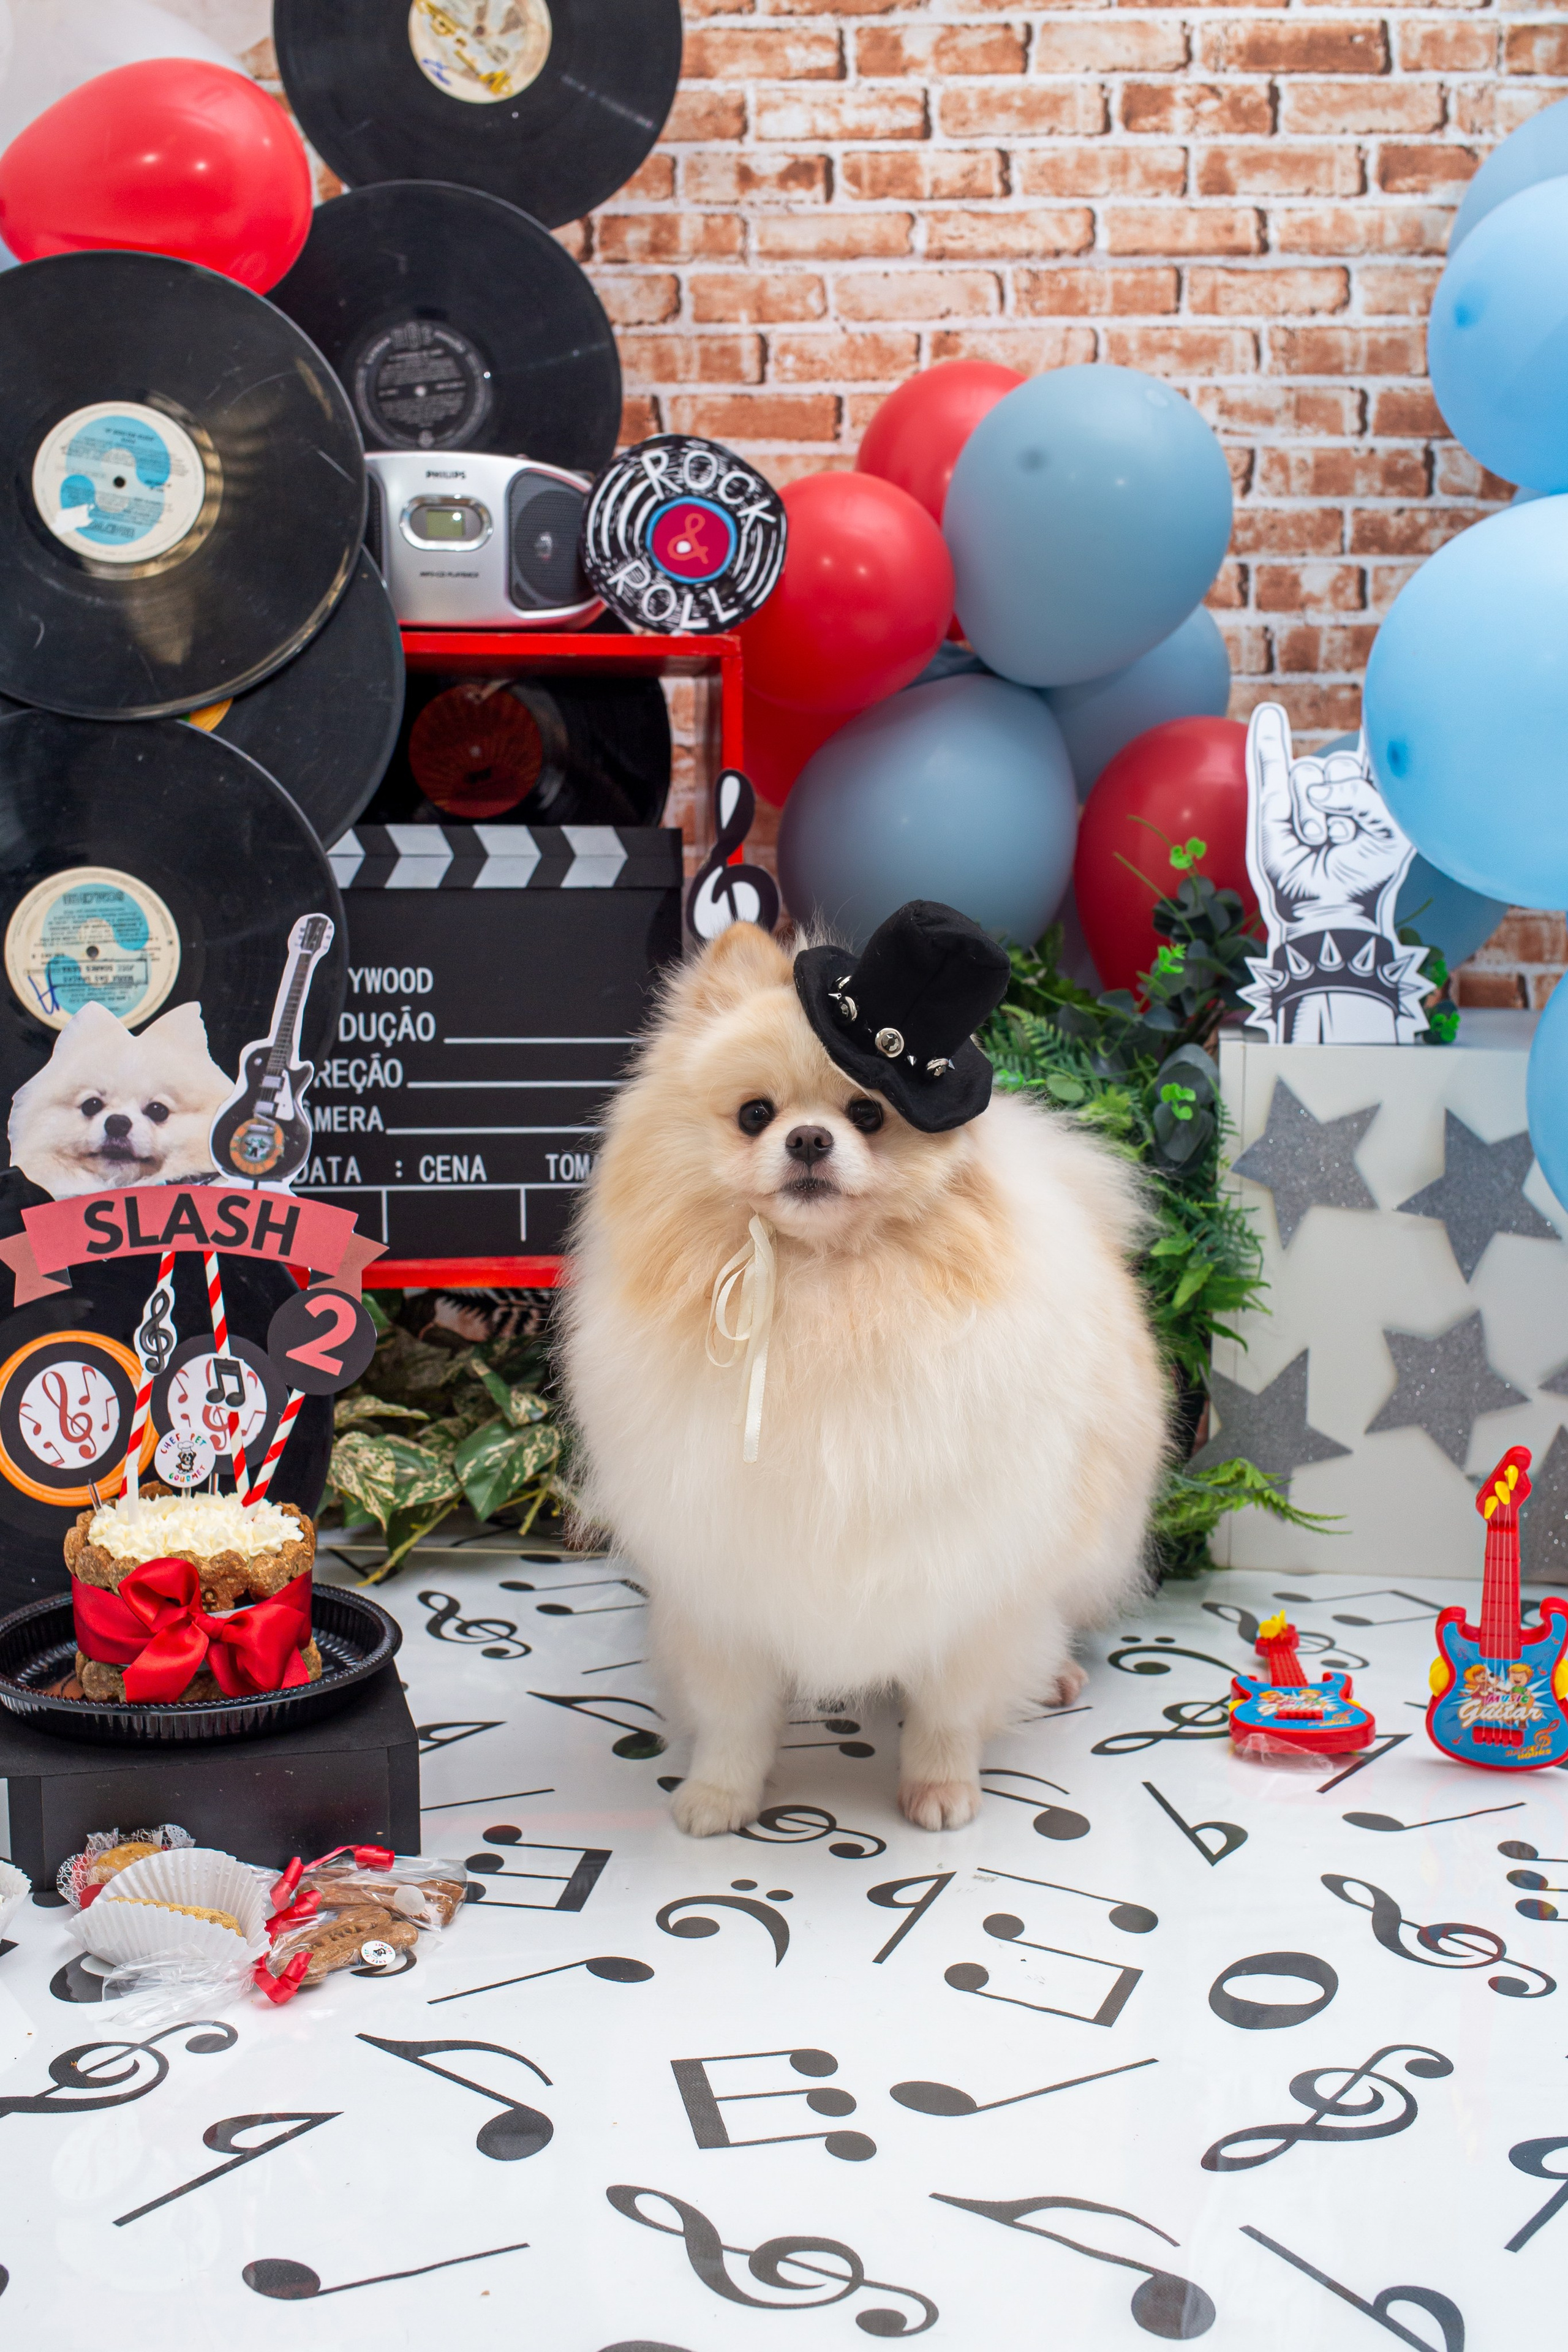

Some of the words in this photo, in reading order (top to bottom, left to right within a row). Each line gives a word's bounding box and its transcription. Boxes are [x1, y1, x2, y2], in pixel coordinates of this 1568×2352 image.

[642, 450, 776, 535] ROCK
[667, 513, 709, 564] &
[607, 560, 739, 629] ROLL
[347, 967, 434, 993] YWOOD
[338, 1005, 436, 1047] DUÇÃO
[313, 1052, 403, 1095] REÇÃO
[303, 1099, 384, 1133] MERA
[419, 1154, 487, 1183] CENA
[545, 1153, 592, 1181] TOM
[84, 1193, 300, 1257] SLASH
[285, 1294, 357, 1376] 2
[160, 1433, 180, 1454] CHEF
[190, 1433, 206, 1446] PET
[168, 1464, 205, 1482] GOURMET
[1458, 1698, 1544, 1728] Guitar
[1487, 1694, 1530, 1703] MUSIC
